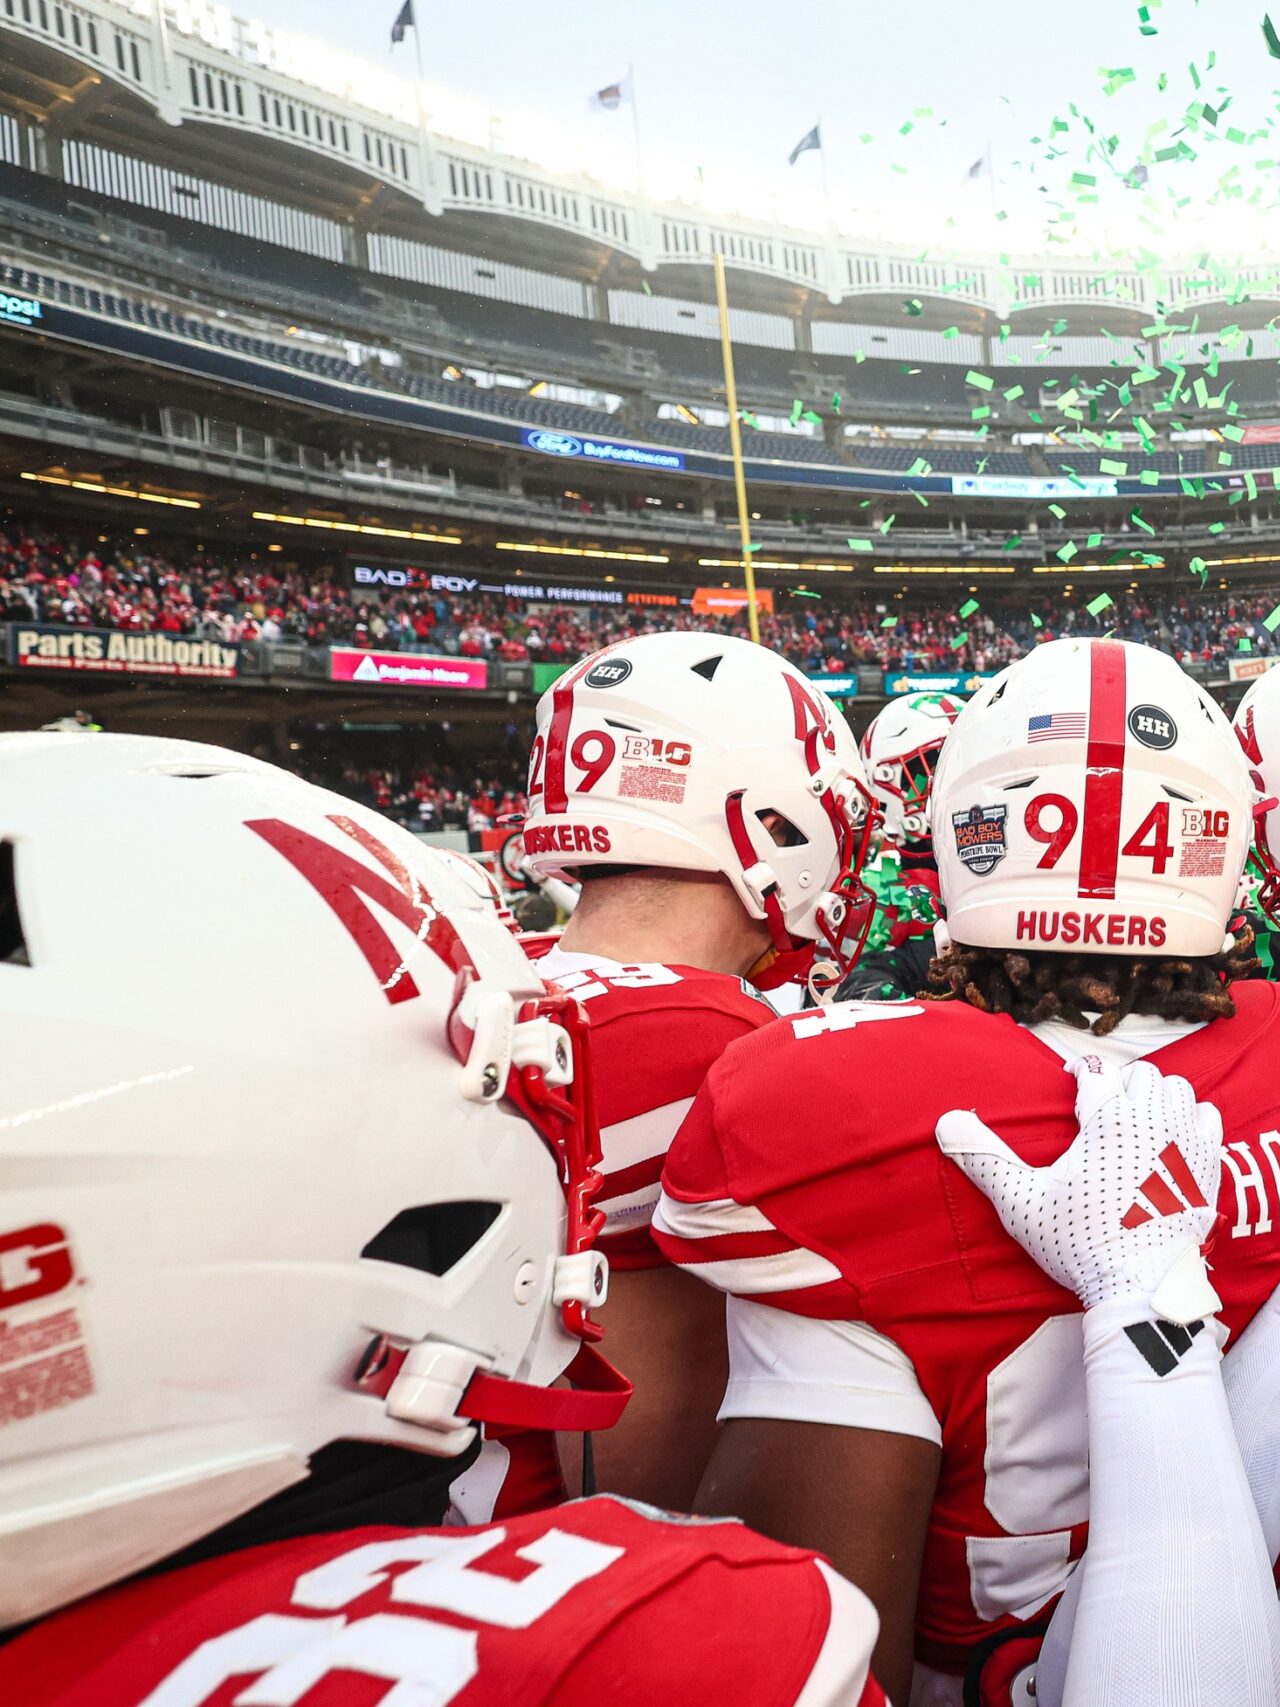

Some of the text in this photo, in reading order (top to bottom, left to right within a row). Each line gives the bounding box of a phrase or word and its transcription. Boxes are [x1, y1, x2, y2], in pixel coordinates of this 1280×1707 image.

[354, 566, 407, 586] BAD
[431, 575, 479, 592] BOY
[18, 631, 104, 659] Parts
[107, 632, 238, 669] Authority
[592, 666, 622, 680] HH
[1137, 715, 1170, 738] HH
[529, 730, 616, 796] 29
[956, 822, 1001, 837] BAD BOY
[957, 830, 1003, 848] MOWERS
[1024, 793, 1174, 875] 94
[242, 815, 482, 1006] N
[1016, 910, 1167, 947] HUSKERS
